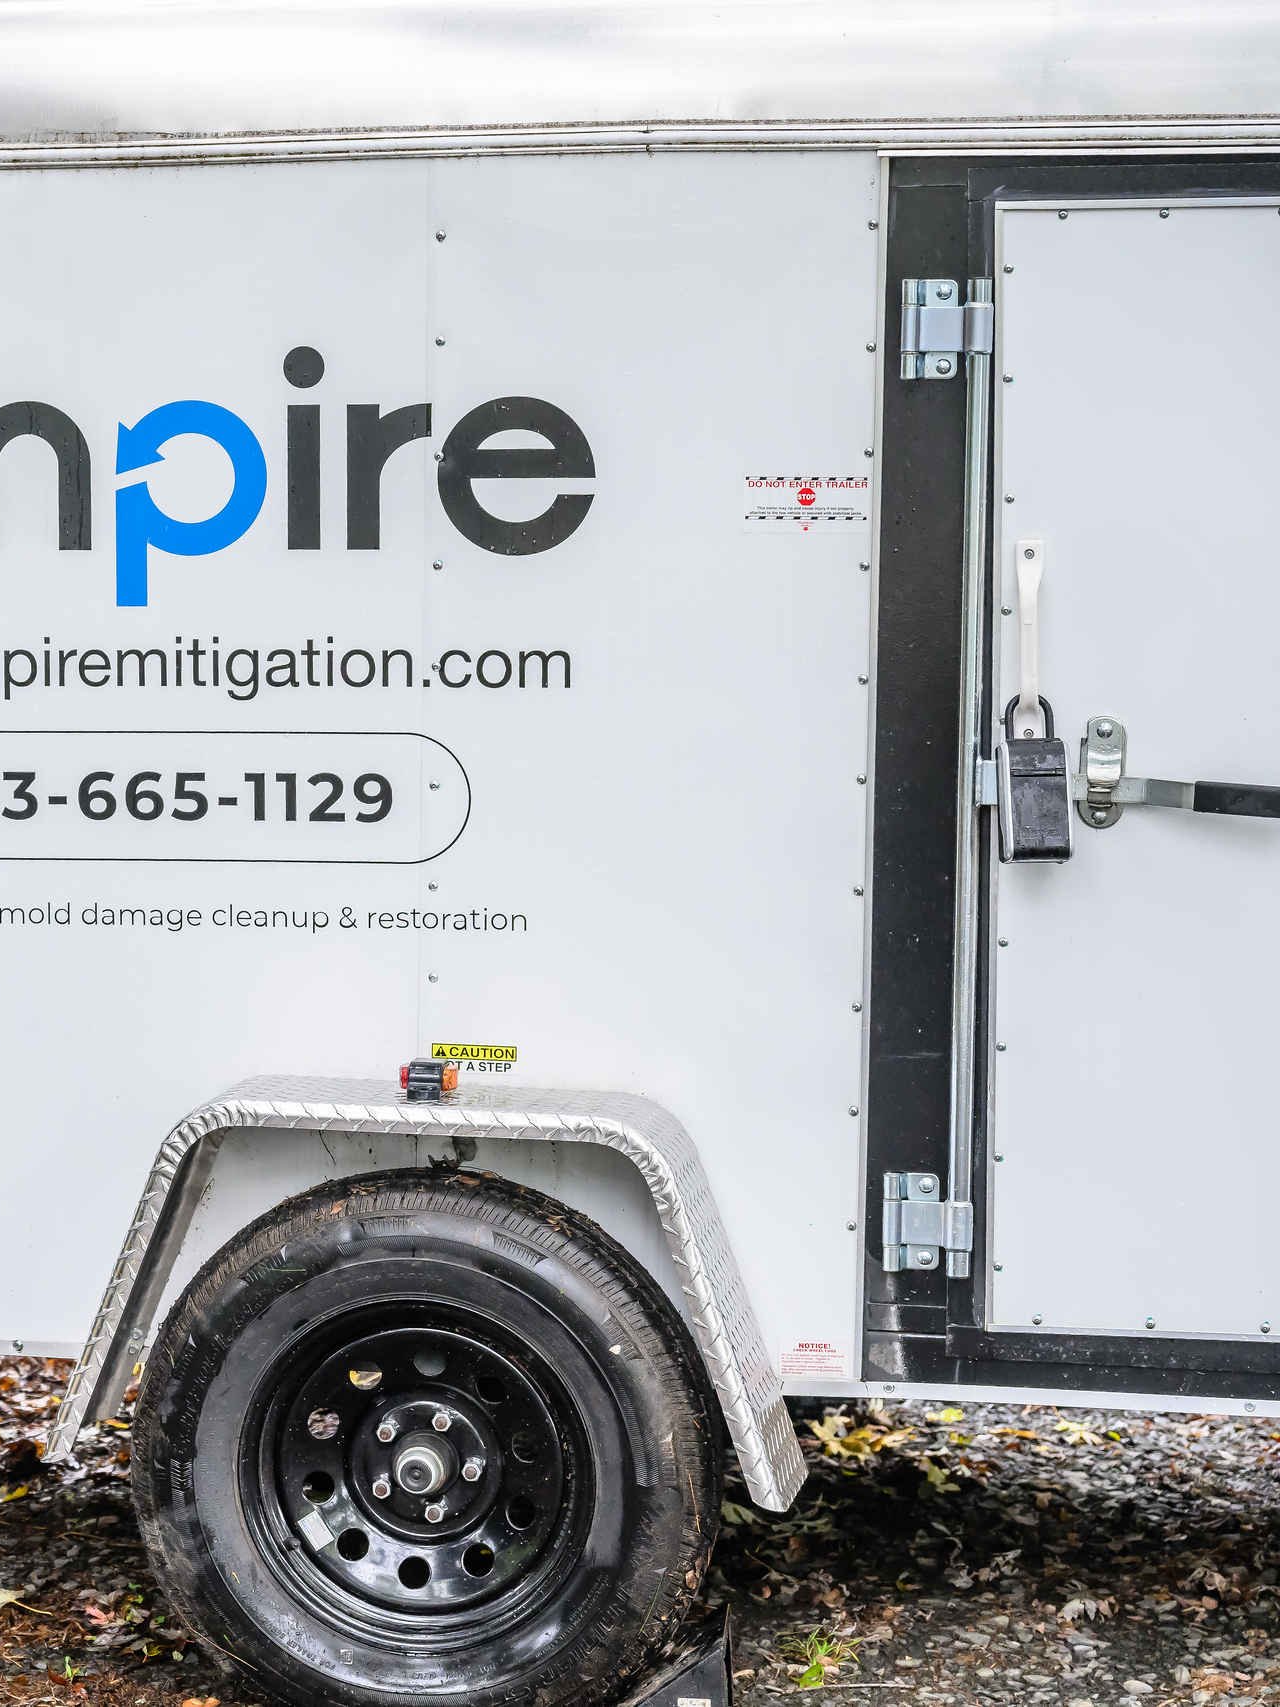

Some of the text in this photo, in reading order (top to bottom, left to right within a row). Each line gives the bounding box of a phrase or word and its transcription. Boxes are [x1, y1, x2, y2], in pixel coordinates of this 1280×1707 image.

[825, 481, 868, 489] TRAILER
[797, 493, 816, 501] STOP
[0, 901, 71, 926] mold
[81, 902, 203, 933] damage
[211, 904, 330, 934] cleanup
[339, 906, 358, 929] &
[367, 907, 529, 933] restoration
[449, 1046, 515, 1059] CAUTION
[466, 1061, 475, 1071] A
[478, 1061, 512, 1073] STEP
